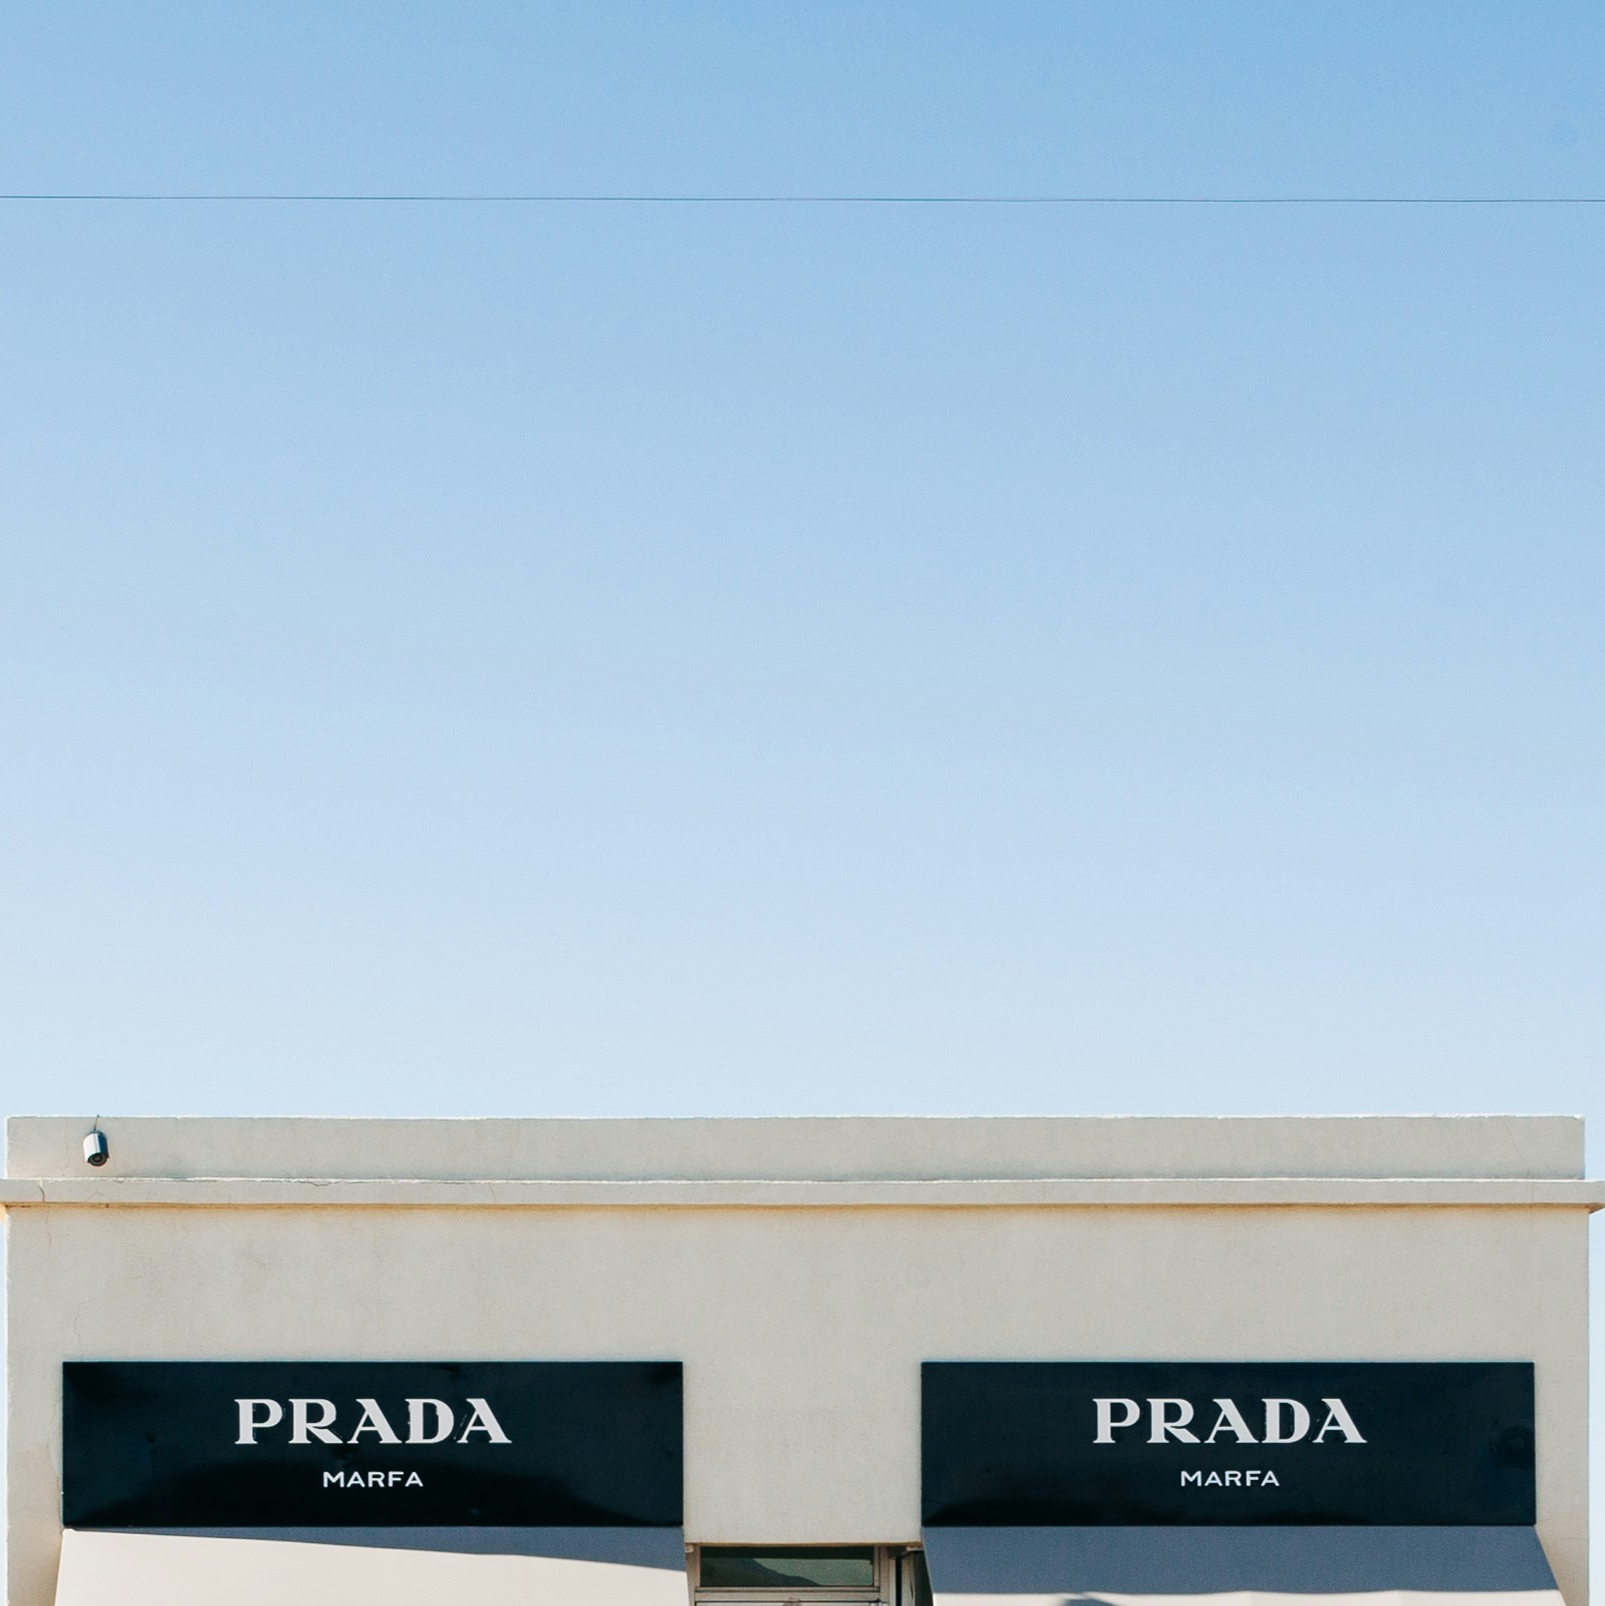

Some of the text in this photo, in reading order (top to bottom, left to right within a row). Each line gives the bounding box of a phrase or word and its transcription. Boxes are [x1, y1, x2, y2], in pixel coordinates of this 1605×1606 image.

[234, 1398, 513, 1445] PRADA
[1092, 1398, 1368, 1444] PRADA
[322, 1471, 424, 1488] MARFA
[1180, 1470, 1280, 1487] MARFA
